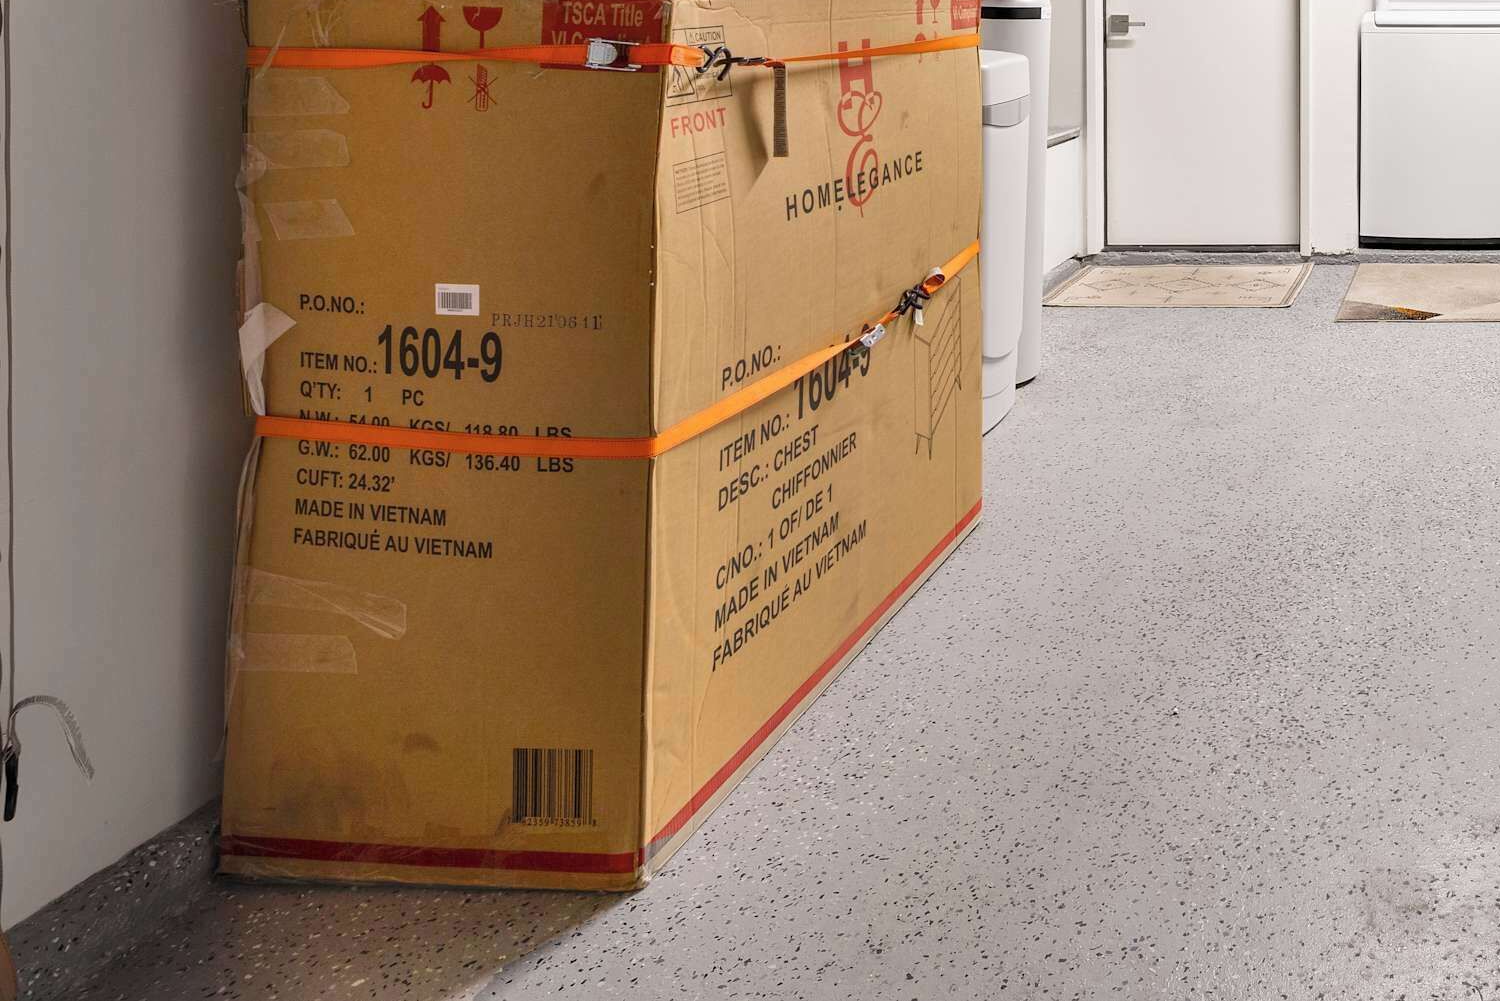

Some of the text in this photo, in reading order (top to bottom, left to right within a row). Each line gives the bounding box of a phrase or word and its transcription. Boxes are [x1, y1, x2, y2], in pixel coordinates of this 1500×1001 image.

[562, 1, 644, 27] TSCA Title
[694, 31, 721, 42] CAUTION
[670, 107, 727, 138] FRONT
[786, 151, 923, 221] HOMELEGANCE
[300, 294, 365, 315] P.O.NO.:
[300, 324, 502, 383] ITEM NO.: 1604-9
[722, 344, 782, 391] P.O.NO.:
[300, 381, 424, 406] Q'TY: 1 PC
[349, 414, 390, 427] 5400
[465, 424, 518, 437] 11880
[719, 429, 756, 471] ITEM
[760, 413, 790, 444] NO.:
[298, 439, 574, 473] G.W.: 62.00 KGS/ 136.40 LBS
[718, 424, 819, 512] DESC.: CHEST
[771, 432, 857, 509] CHIFFONNIER
[296, 468, 395, 492] CUFT: 24.32'
[295, 498, 446, 526] MADE IN VIETNAM
[385, 534, 409, 552] AU
[414, 536, 493, 558] VIETNAM
[715, 483, 833, 590] C/NO.: 1 OF/ DE 1
[714, 511, 840, 632] MADE IN VIETNAM
[792, 568, 812, 601] AU
[815, 519, 867, 580] VIETNAM
